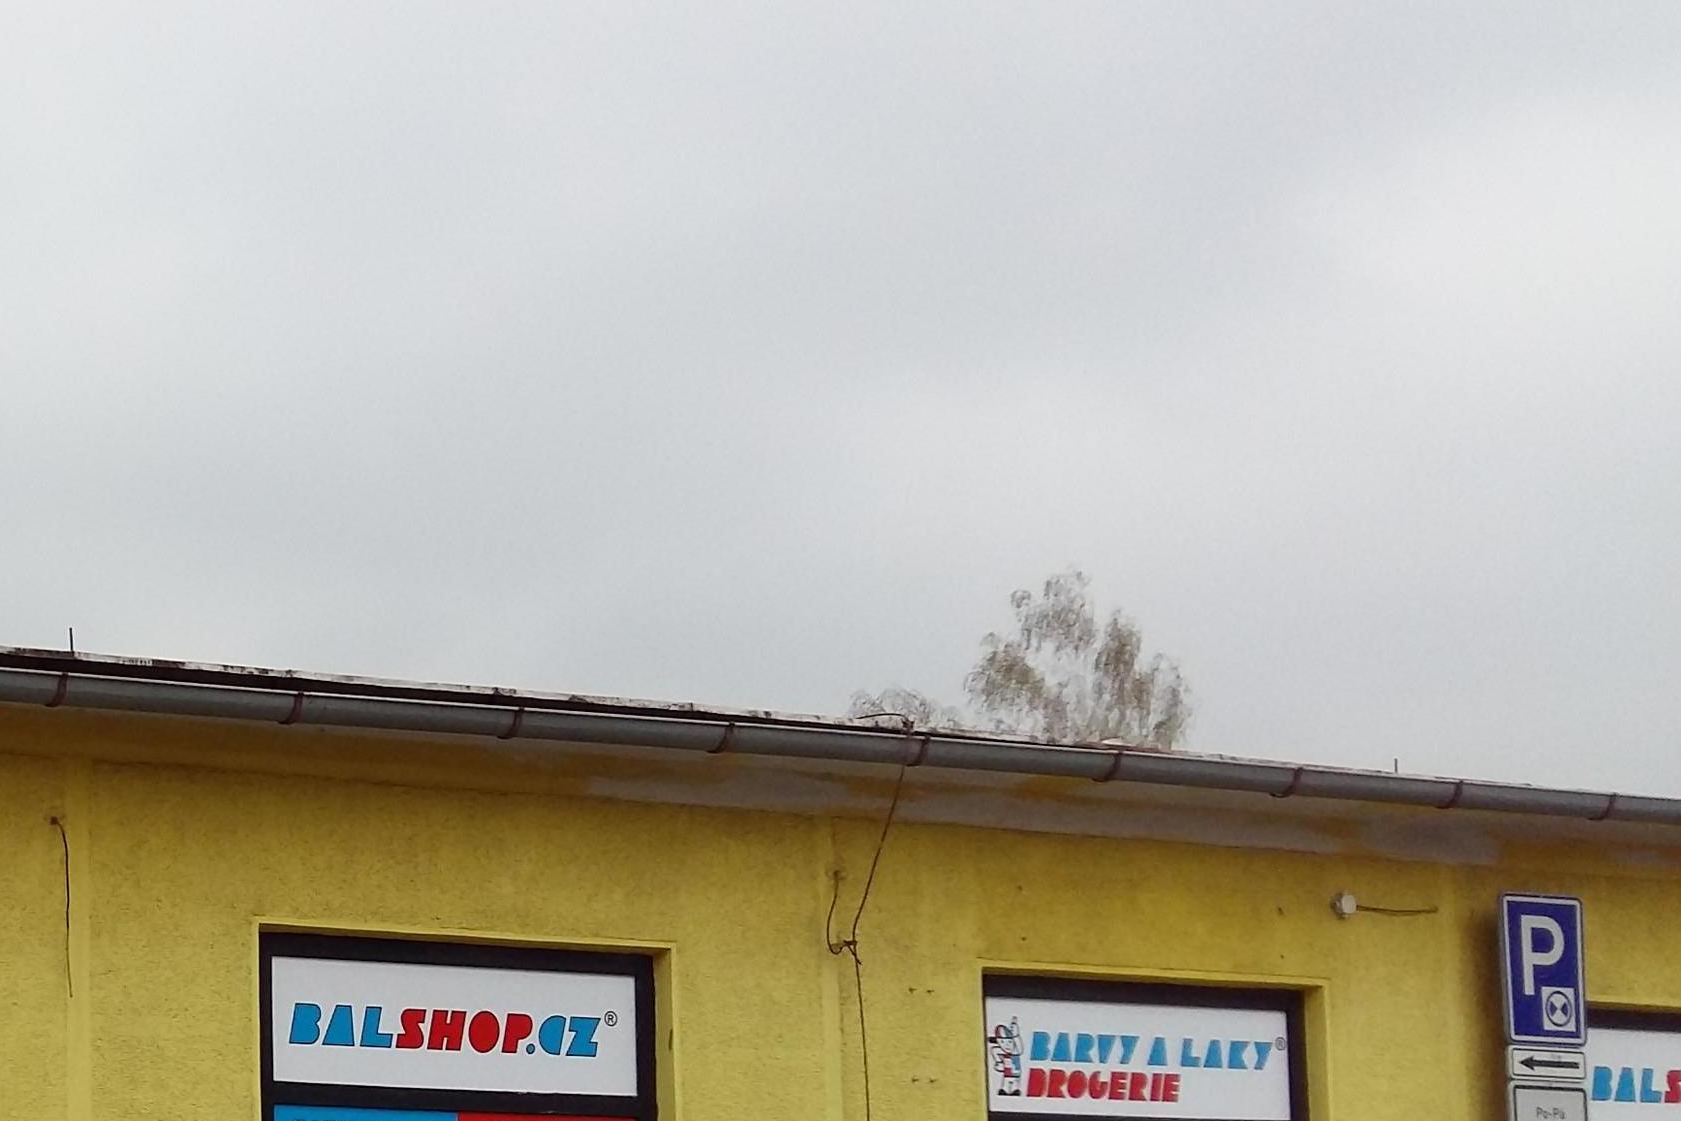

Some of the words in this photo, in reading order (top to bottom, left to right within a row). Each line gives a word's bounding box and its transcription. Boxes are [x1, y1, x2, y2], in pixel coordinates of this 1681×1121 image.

[1521, 915, 1565, 995] P
[1029, 1031, 1140, 1064] BARVY
[1147, 1037, 1168, 1066] A
[1026, 1067, 1181, 1102] DROGERIE
